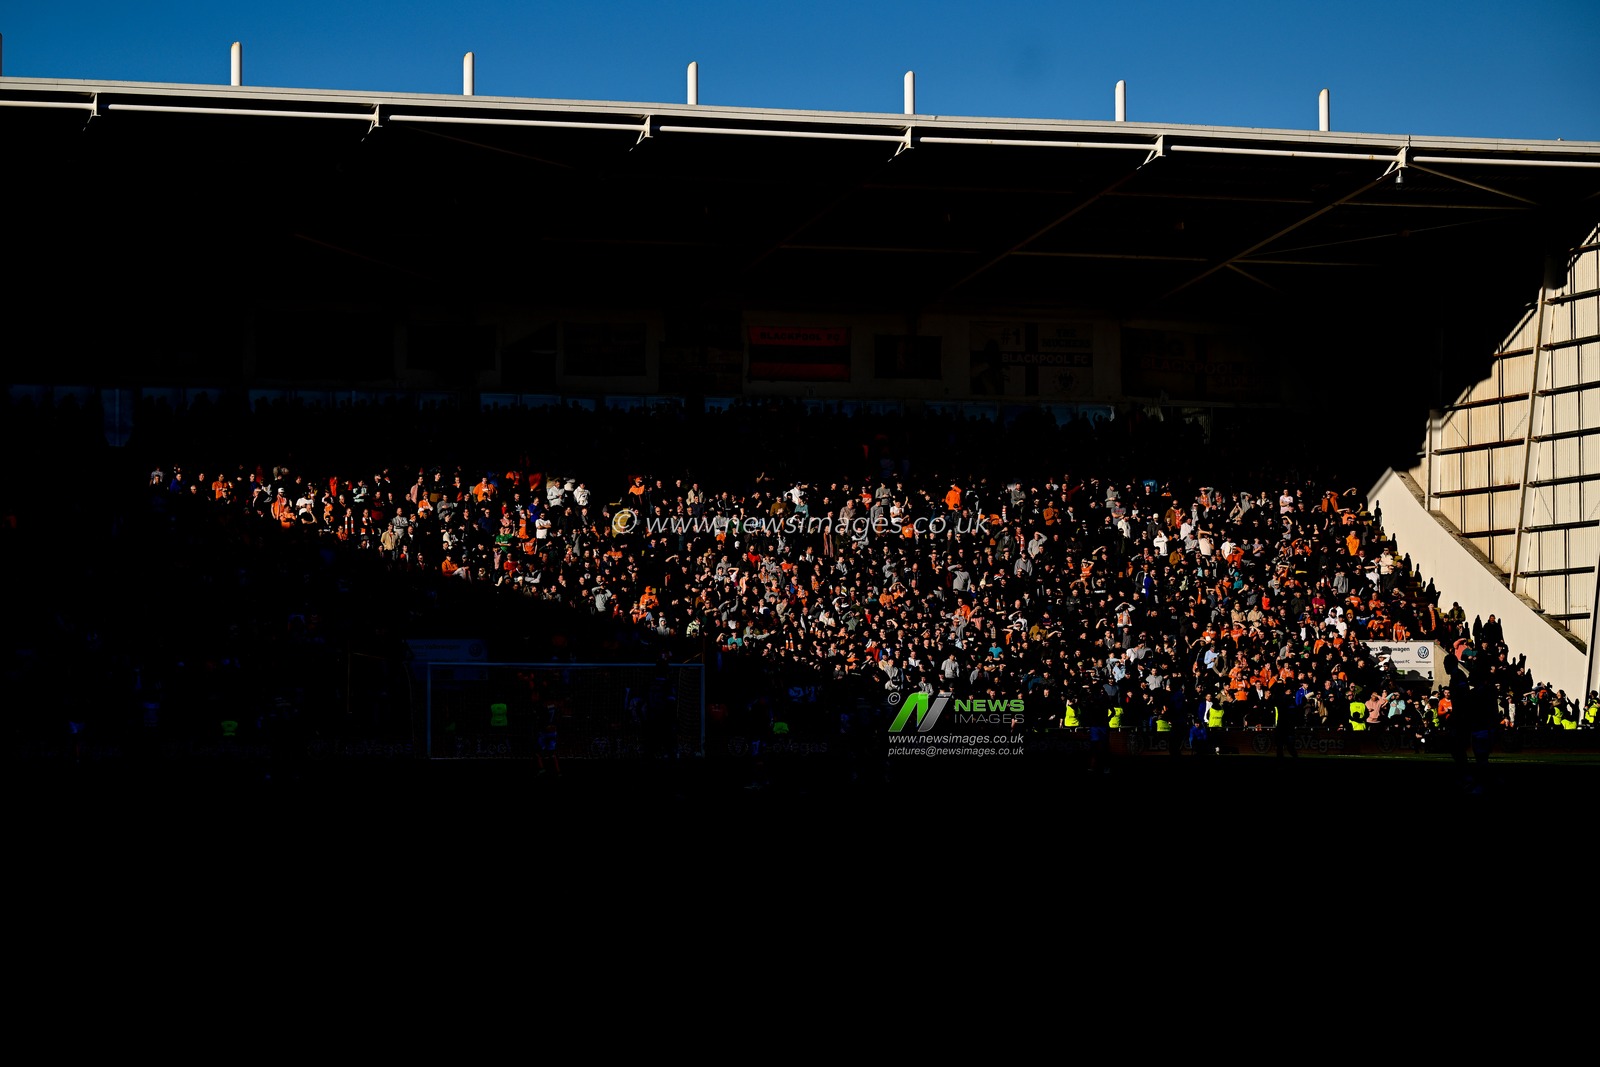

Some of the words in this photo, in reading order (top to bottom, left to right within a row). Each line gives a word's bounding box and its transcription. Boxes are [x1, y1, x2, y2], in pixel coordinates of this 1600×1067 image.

[760, 332, 820, 341] BLACKPOOL
[1001, 353, 1071, 364] BLACKPOOL
[1073, 354, 1089, 365] FC
[1428, 671, 1433, 679] 1
[762, 738, 828, 757] oVegas
[1025, 736, 1091, 756] eoVegas
[1294, 735, 1345, 753] oVegas
